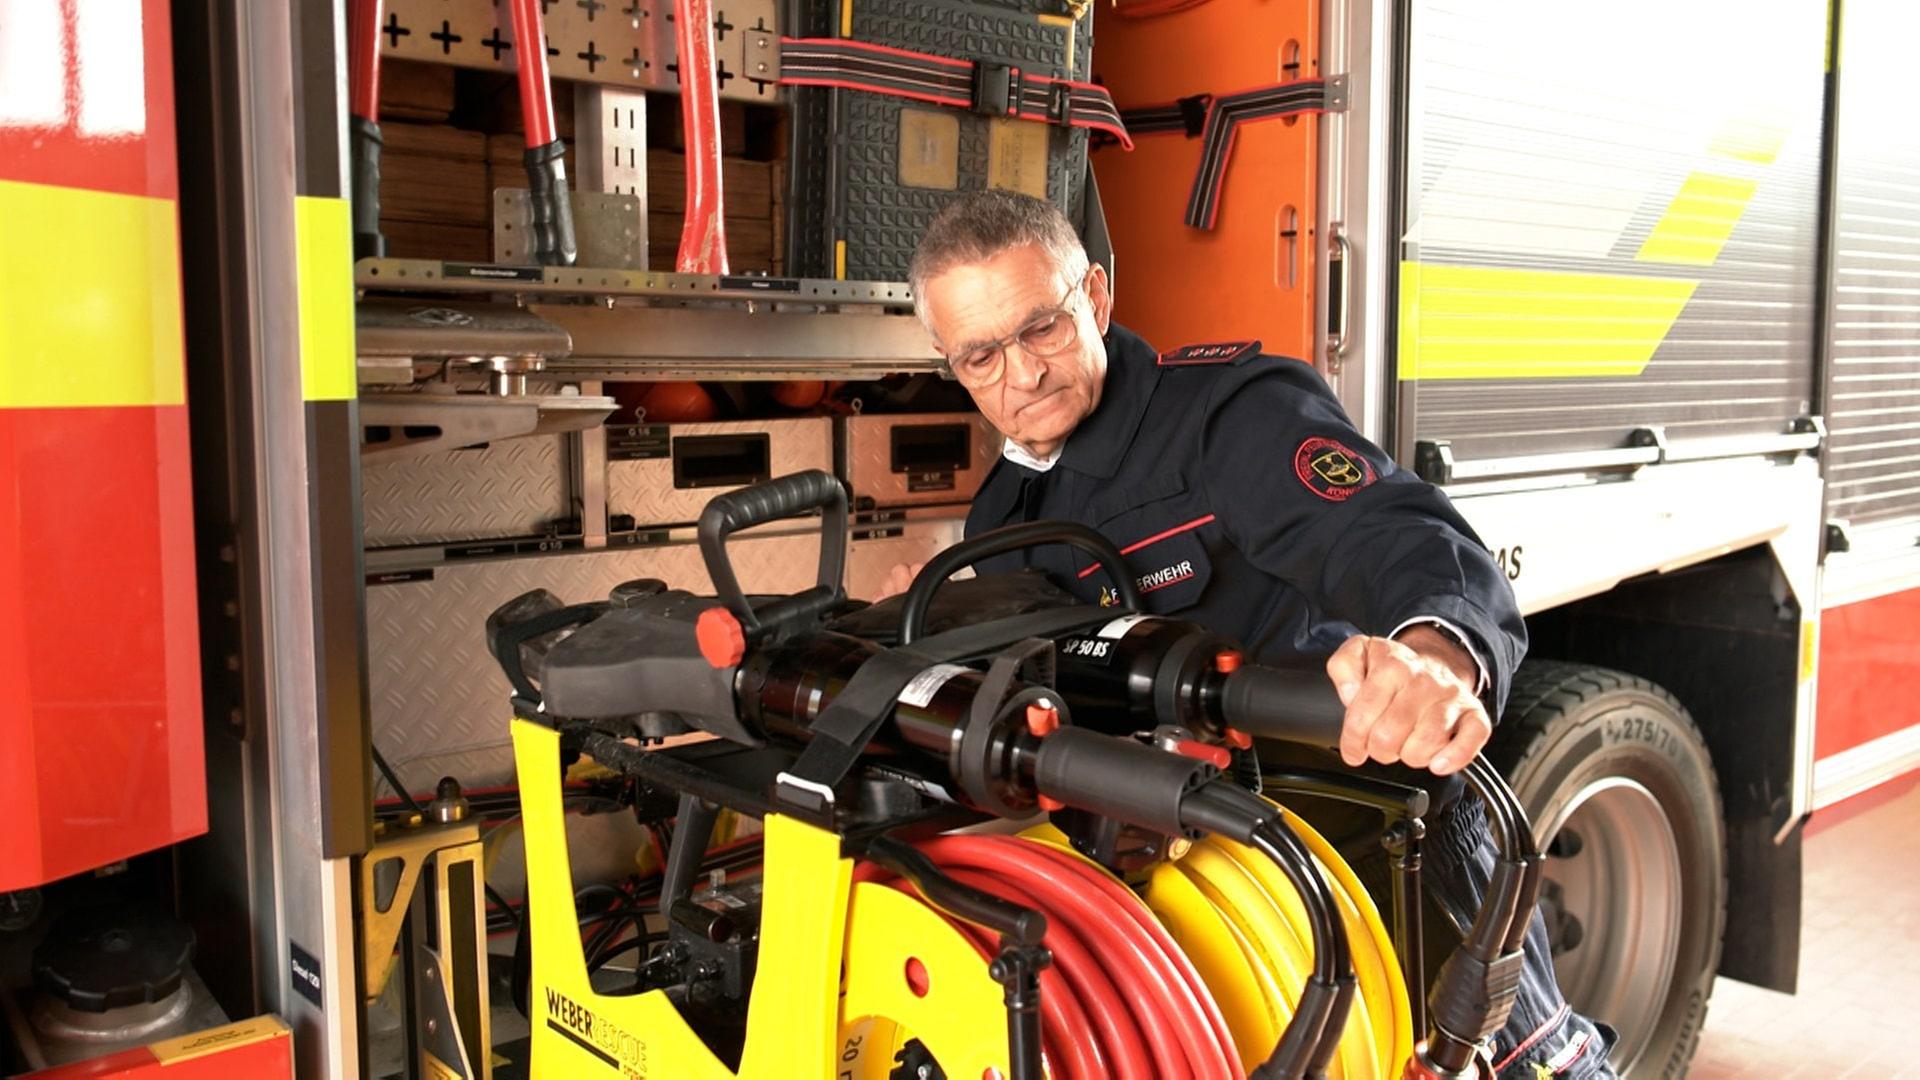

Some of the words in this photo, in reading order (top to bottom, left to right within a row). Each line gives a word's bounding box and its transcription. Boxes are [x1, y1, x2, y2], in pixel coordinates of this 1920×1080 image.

[1111, 560, 1194, 600] FERWEHR
[1489, 545, 1522, 581] AS
[1077, 640, 1095, 656] 50
[1092, 641, 1111, 658] BS
[545, 985, 593, 1040] WEBER
